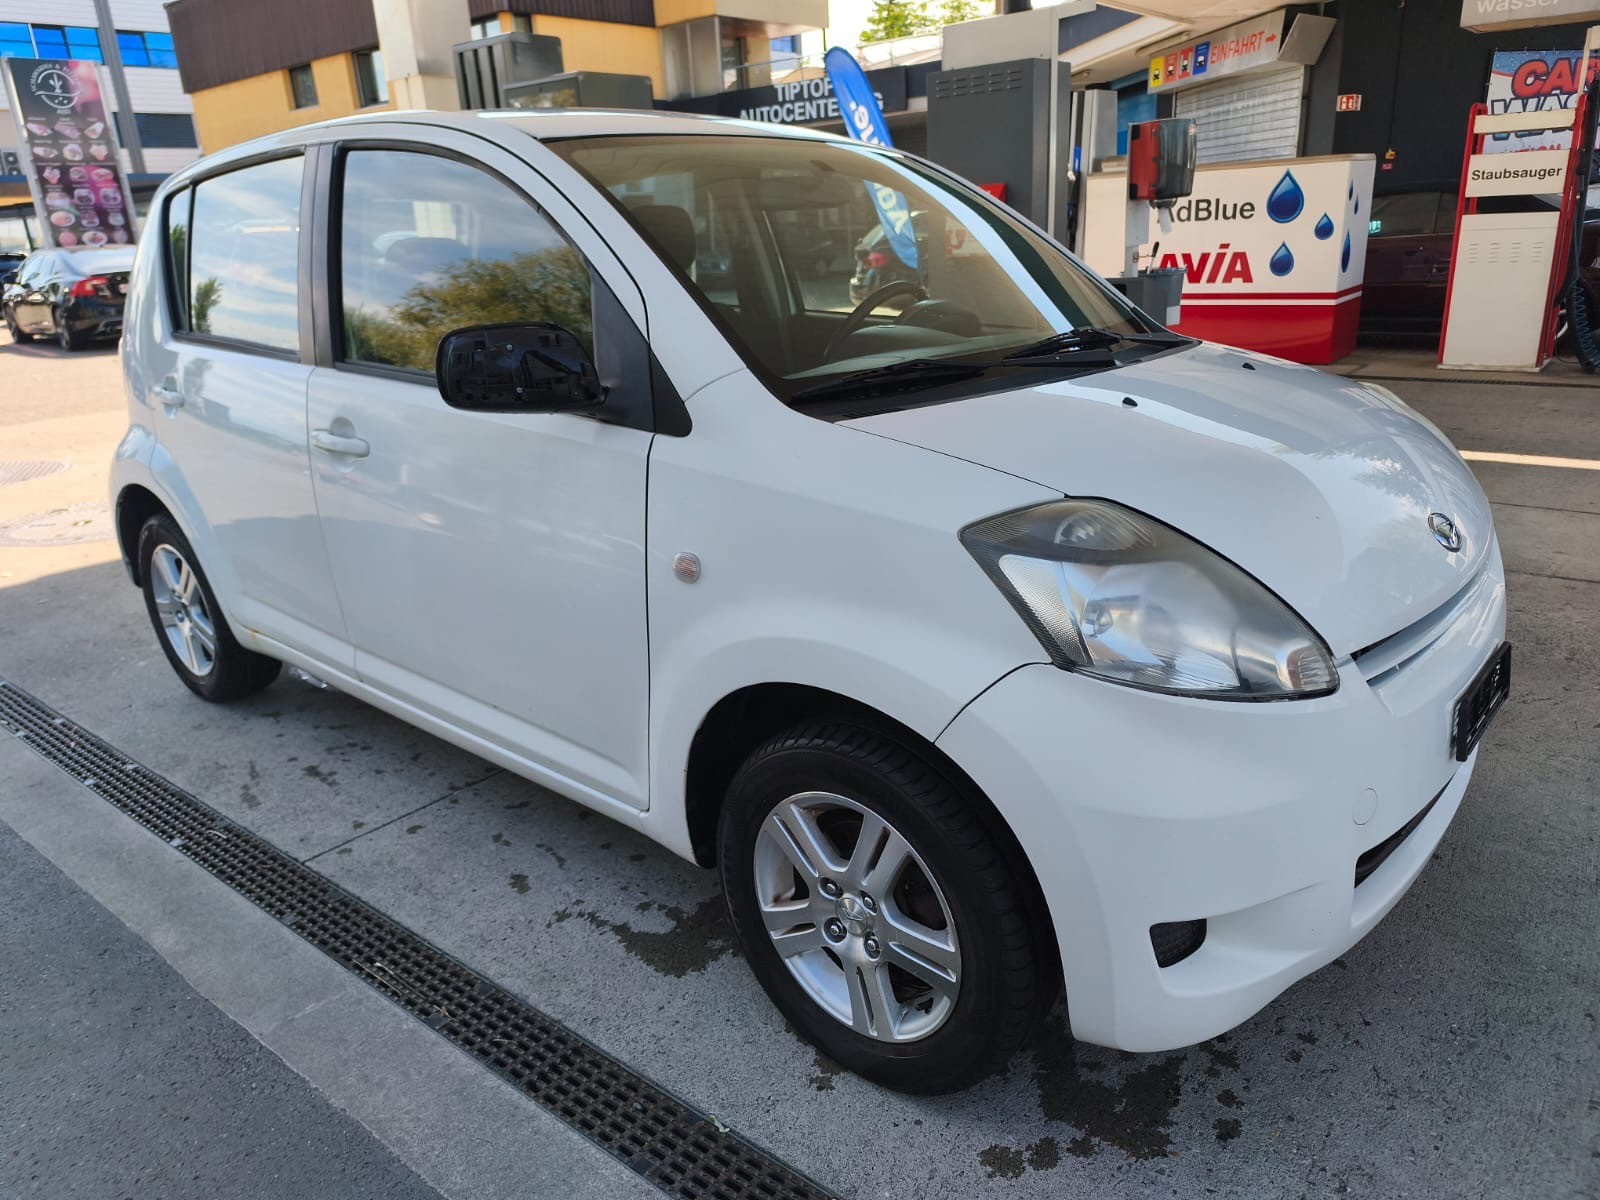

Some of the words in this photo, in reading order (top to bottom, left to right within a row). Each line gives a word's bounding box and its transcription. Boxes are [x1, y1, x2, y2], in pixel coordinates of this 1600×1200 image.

[1209, 32, 1265, 64] EINFAHRT
[739, 98, 842, 124] AUTOCENTE
[1471, 168, 1563, 181] Staubsauger
